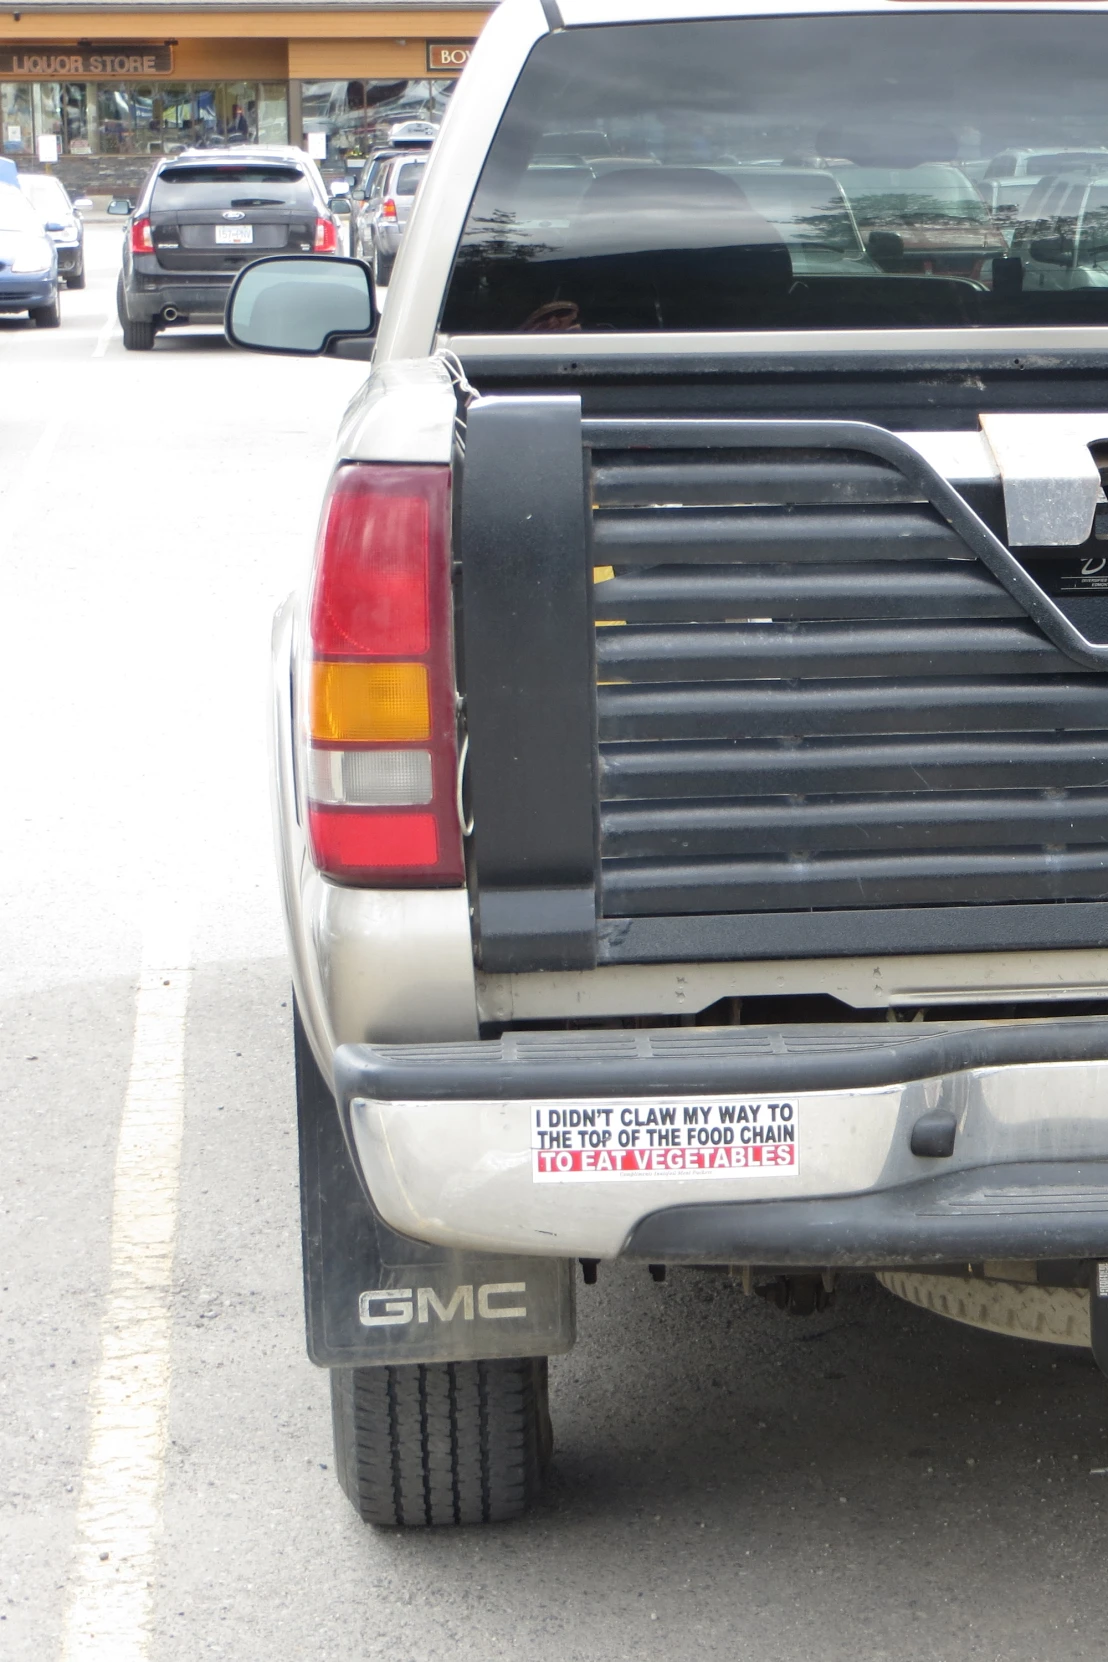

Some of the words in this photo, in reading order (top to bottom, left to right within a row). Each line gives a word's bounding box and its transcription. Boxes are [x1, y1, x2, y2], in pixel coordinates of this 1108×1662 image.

[13, 55, 83, 73] LIQUOR
[89, 55, 156, 73] STORE
[441, 49, 472, 64] BO
[535, 1109, 541, 1128] I
[549, 1108, 614, 1128] DIDN'T
[620, 1106, 676, 1127] CLAW
[683, 1105, 712, 1125] MY
[718, 1104, 761, 1124] WAY
[767, 1102, 794, 1122] TO
[537, 1130, 572, 1149] THE
[578, 1129, 612, 1148] TOP
[618, 1128, 640, 1147] OF
[646, 1127, 681, 1147] THE
[687, 1126, 735, 1146] FOOD
[740, 1124, 795, 1144] CHAIN
[540, 1151, 573, 1172] TO
[584, 1149, 627, 1171] EAT
[632, 1145, 791, 1170] VEGETABLES
[358, 1282, 527, 1327] GMC
